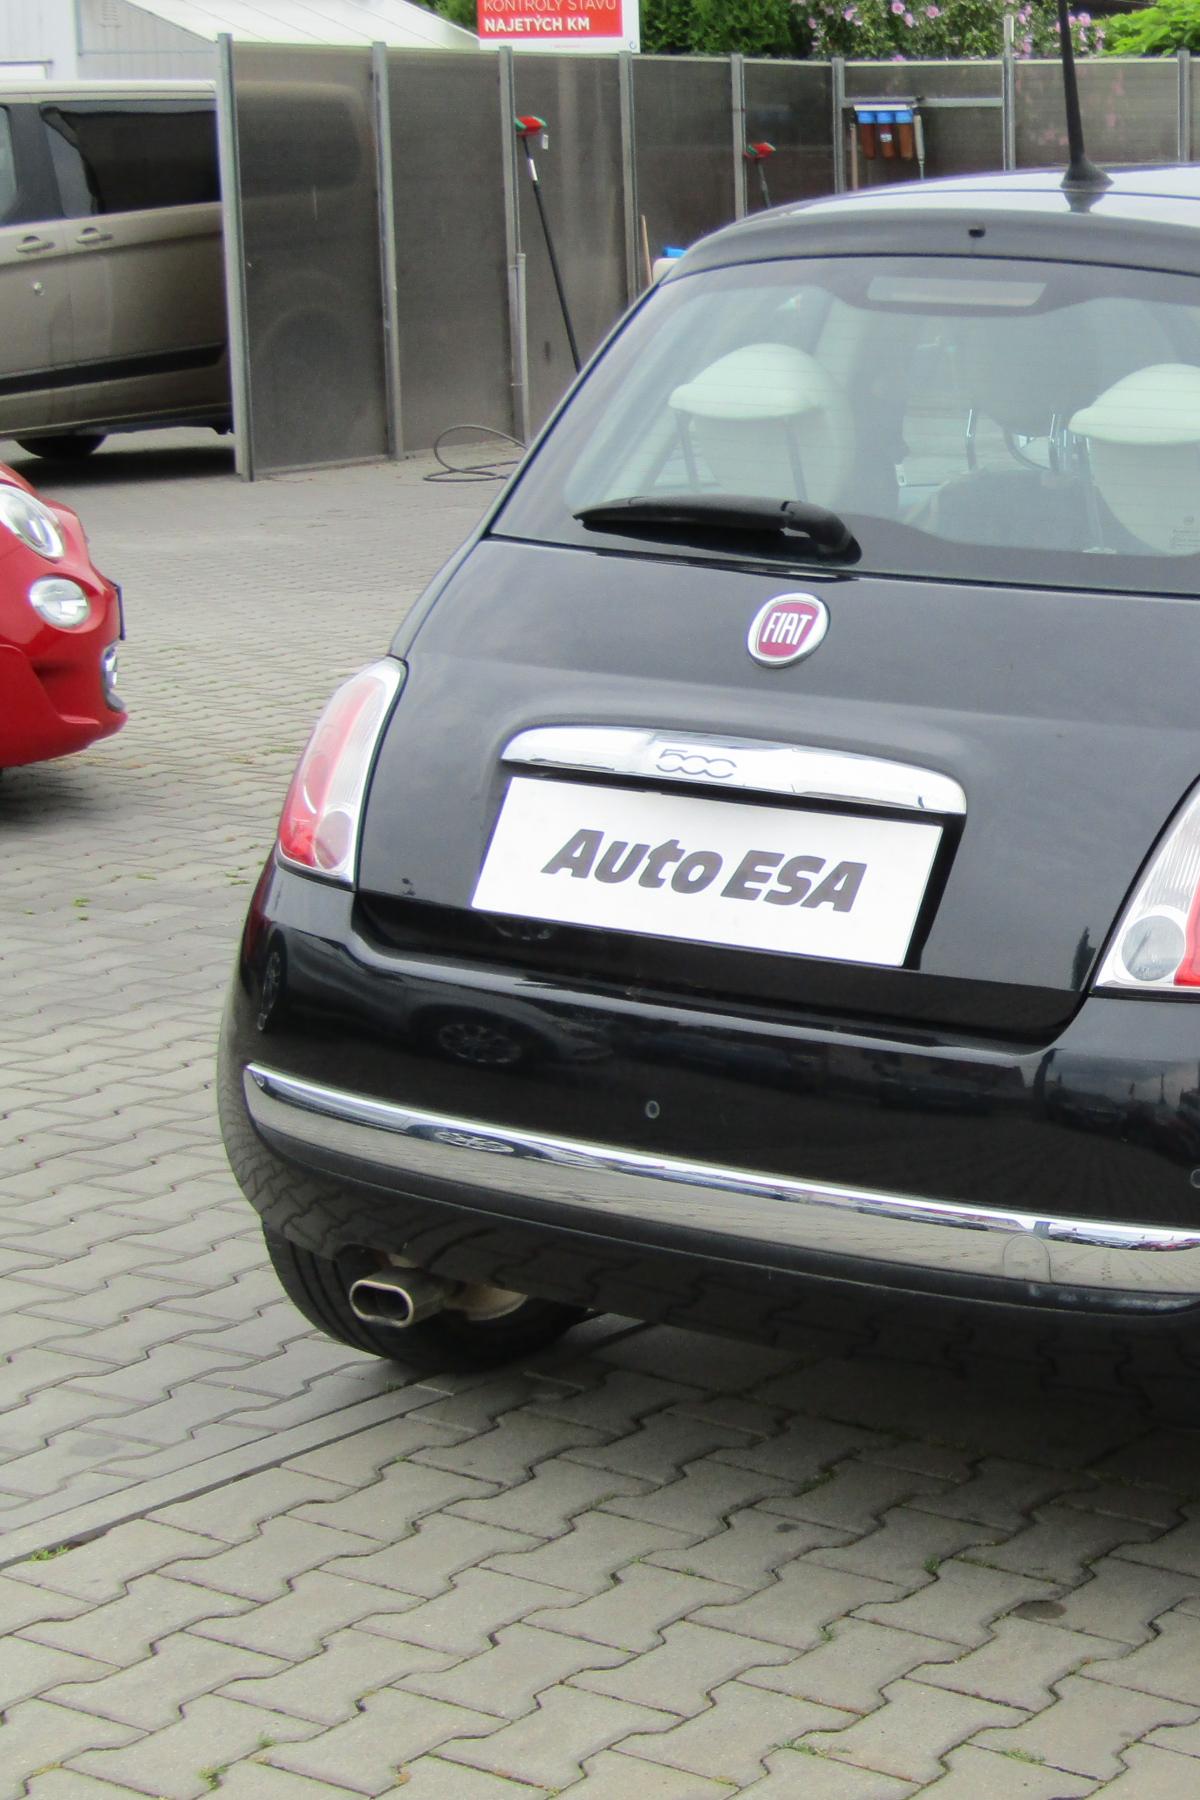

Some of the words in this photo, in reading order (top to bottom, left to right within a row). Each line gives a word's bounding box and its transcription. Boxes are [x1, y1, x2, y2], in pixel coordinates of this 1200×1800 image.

[484, 14, 563, 32] NAJETÝCH
[567, 17, 590, 31] KM
[762, 612, 813, 646] FIAT
[656, 749, 737, 778] 500
[540, 829, 723, 894] Auto
[720, 850, 867, 913] ESA
